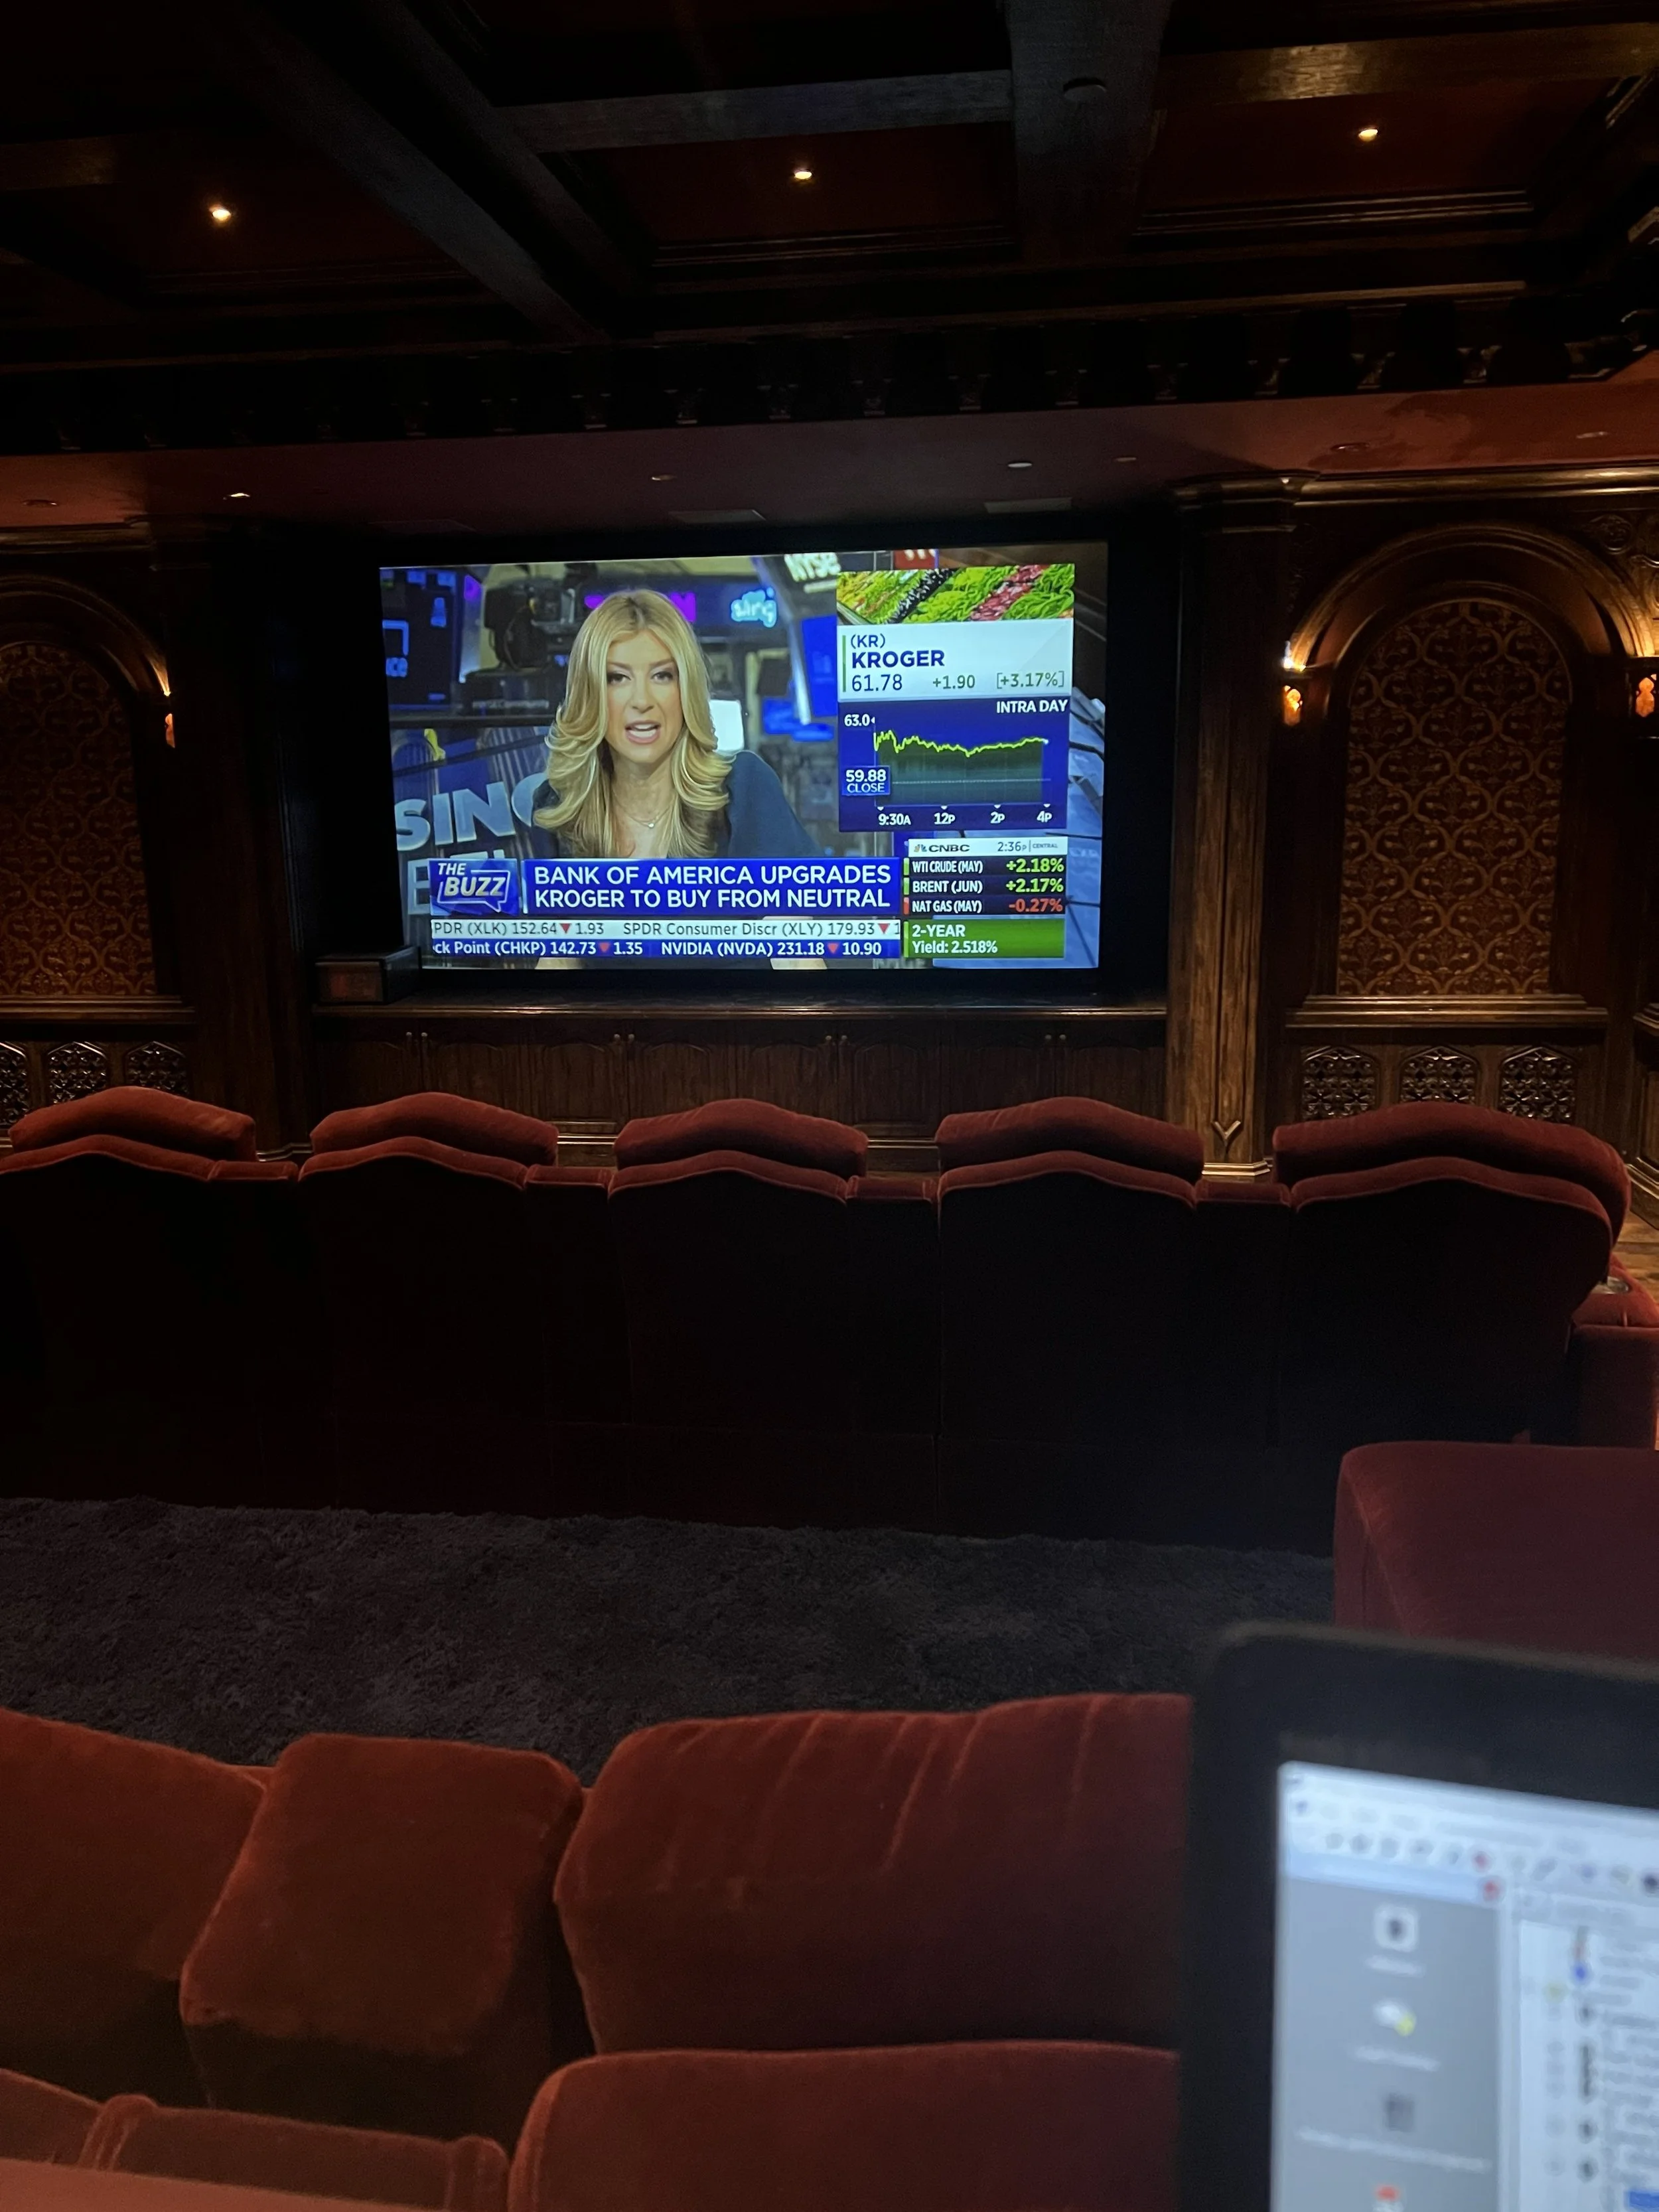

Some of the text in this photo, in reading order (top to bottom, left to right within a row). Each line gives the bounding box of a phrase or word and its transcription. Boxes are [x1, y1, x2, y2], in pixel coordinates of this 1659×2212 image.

[850, 633, 887, 650] (KR)
[851, 650, 945, 669] KROGER
[851, 670, 1065, 692] 61.78 +1.90 [+3.17%]
[996, 699, 1068, 713] INTRA DAY
[844, 714, 871, 727] 63.0
[845, 769, 887, 782] 59.88
[847, 783, 885, 794] CLOSE
[878, 810, 1052, 826] 9:30A 12P 2P 4P
[929, 844, 970, 853] CNBC
[438, 863, 467, 875] THE
[912, 857, 1065, 874] WTI CRUDE (MAY) +2.18%
[534, 865, 892, 885] BANK OF AMERICA UPGRADES
[444, 877, 506, 897] BUZZ
[912, 878, 1064, 894] BRENT (JUN) +2.17%
[535, 889, 891, 909] KROGER TO BUY FROM NEUTRAL
[912, 898, 1064, 914] NAT GAS (MAY) -0.27%
[434, 922, 463, 934] PDR
[467, 921, 507, 936] (XLK)
[512, 922, 557, 935] 152.64
[575, 922, 605, 934] 1.93
[623, 923, 662, 935] SPDR
[666, 922, 737, 935] Consumer
[742, 922, 778, 935] Discr
[782, 922, 823, 936] (XLY)
[828, 922, 875, 935] 179.93
[912, 924, 966, 938] 2-YEAR
[433, 940, 882, 957] ck Point (CHKP) 142.73 1.35 NVIDIA (NVDA) 231.18 10.90
[912, 940, 999, 954] Yield: 2.518%
